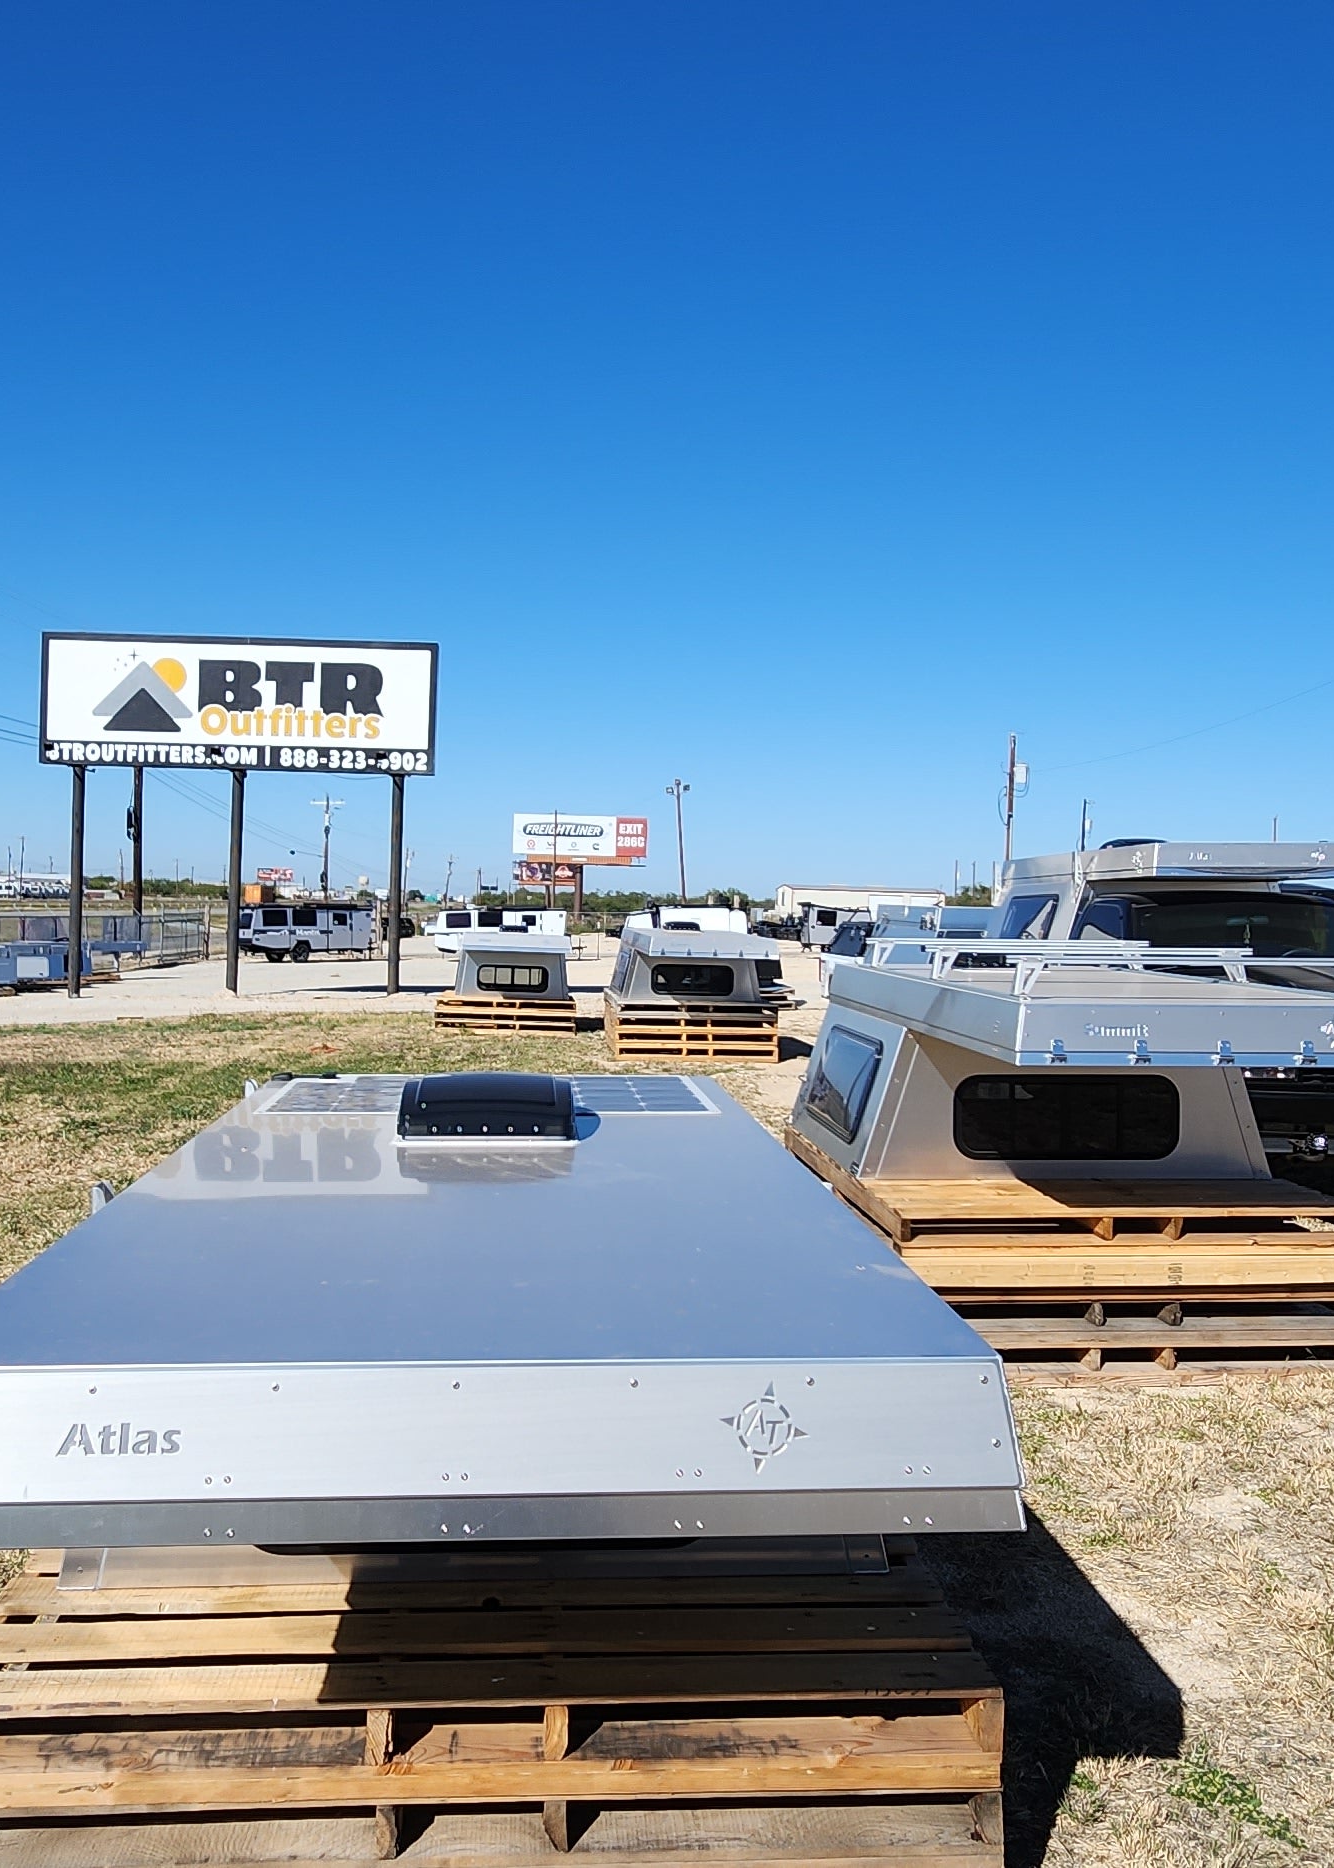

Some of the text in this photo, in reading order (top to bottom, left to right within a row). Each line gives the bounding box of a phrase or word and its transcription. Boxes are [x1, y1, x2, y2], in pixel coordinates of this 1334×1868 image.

[198, 659, 384, 718] BTR
[200, 704, 381, 740] Outfitters
[525, 823, 602, 837] FREIGHTLINER
[618, 823, 644, 835] EXIT
[55, 1422, 182, 1457] Atlas
